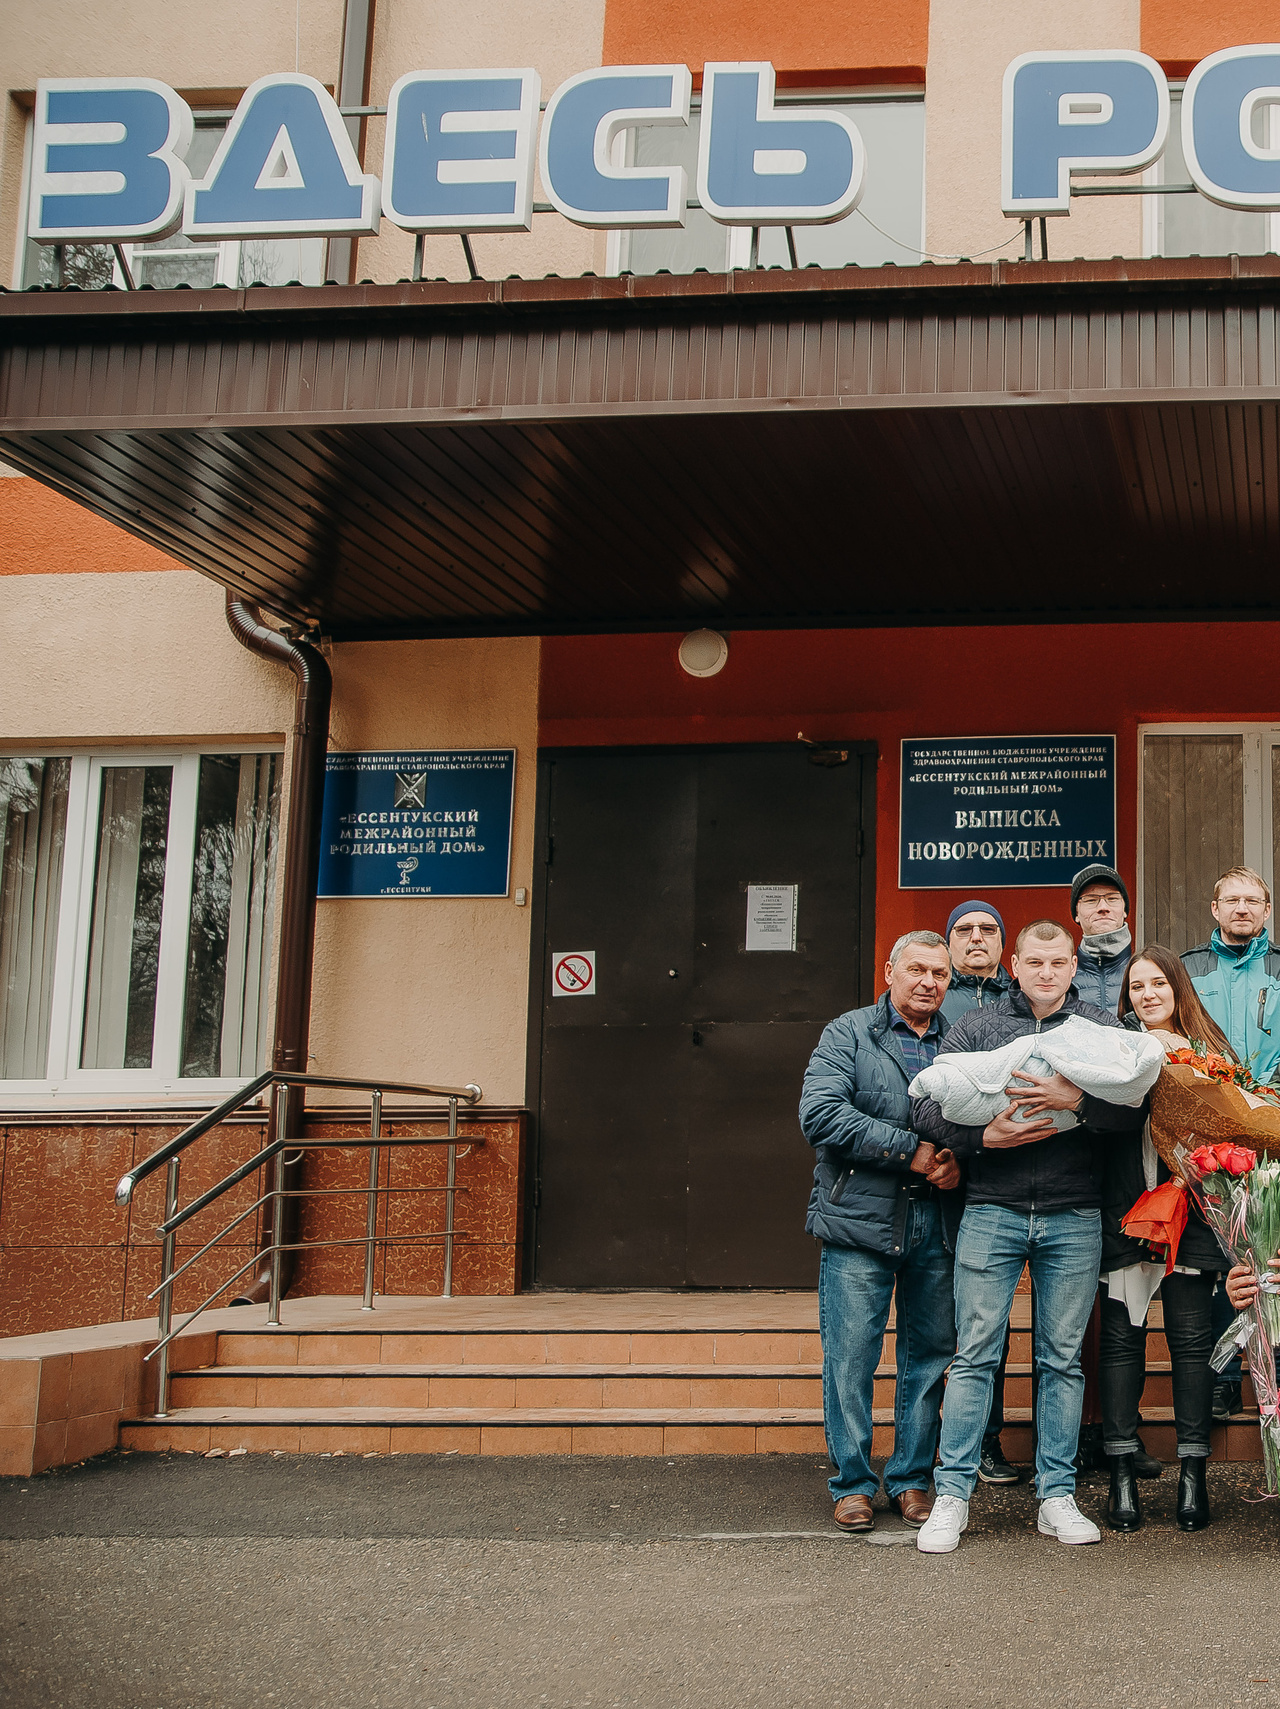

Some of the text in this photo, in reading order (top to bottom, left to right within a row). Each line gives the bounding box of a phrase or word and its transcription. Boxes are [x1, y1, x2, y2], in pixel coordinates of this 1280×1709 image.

[28, 60, 865, 245] ЗДЕСЬ
[396, 755, 450, 764] БЮДЖЕТНОЕ
[451, 754, 510, 762] УЧРЕЖДЕНИЕ
[909, 746, 1108, 758] ГОСУДАРСТВЕННОЕ БЮДЖЕТНОЕ УЧРЕЖДЕНИЕ
[400, 763, 482, 771] СТАВРОПОЛЬСКОГО
[483, 762, 506, 770] КРАЯ
[912, 755, 1105, 766] ЗДРАВООХРАНЕНИЯ СТАВРОПОЛЬСКОГО КРАЯ
[909, 768, 1107, 783] «ЕССЕНТУКСКИЙ МЕЖРАЙОННЫЙ
[953, 783, 1063, 796] РОДИЛЬНЫЙ ДОМ»
[339, 809, 479, 824] «ЕССЕНТУКСКИЙ
[954, 809, 1061, 829] ВЫПИСКА
[340, 825, 477, 839] МЕЖРАЙОННЫЙ
[330, 840, 485, 856] РОДИЛЬНЫЙ ДОМ»
[907, 839, 1107, 861] НОВОРОЖДЕННЫХ
